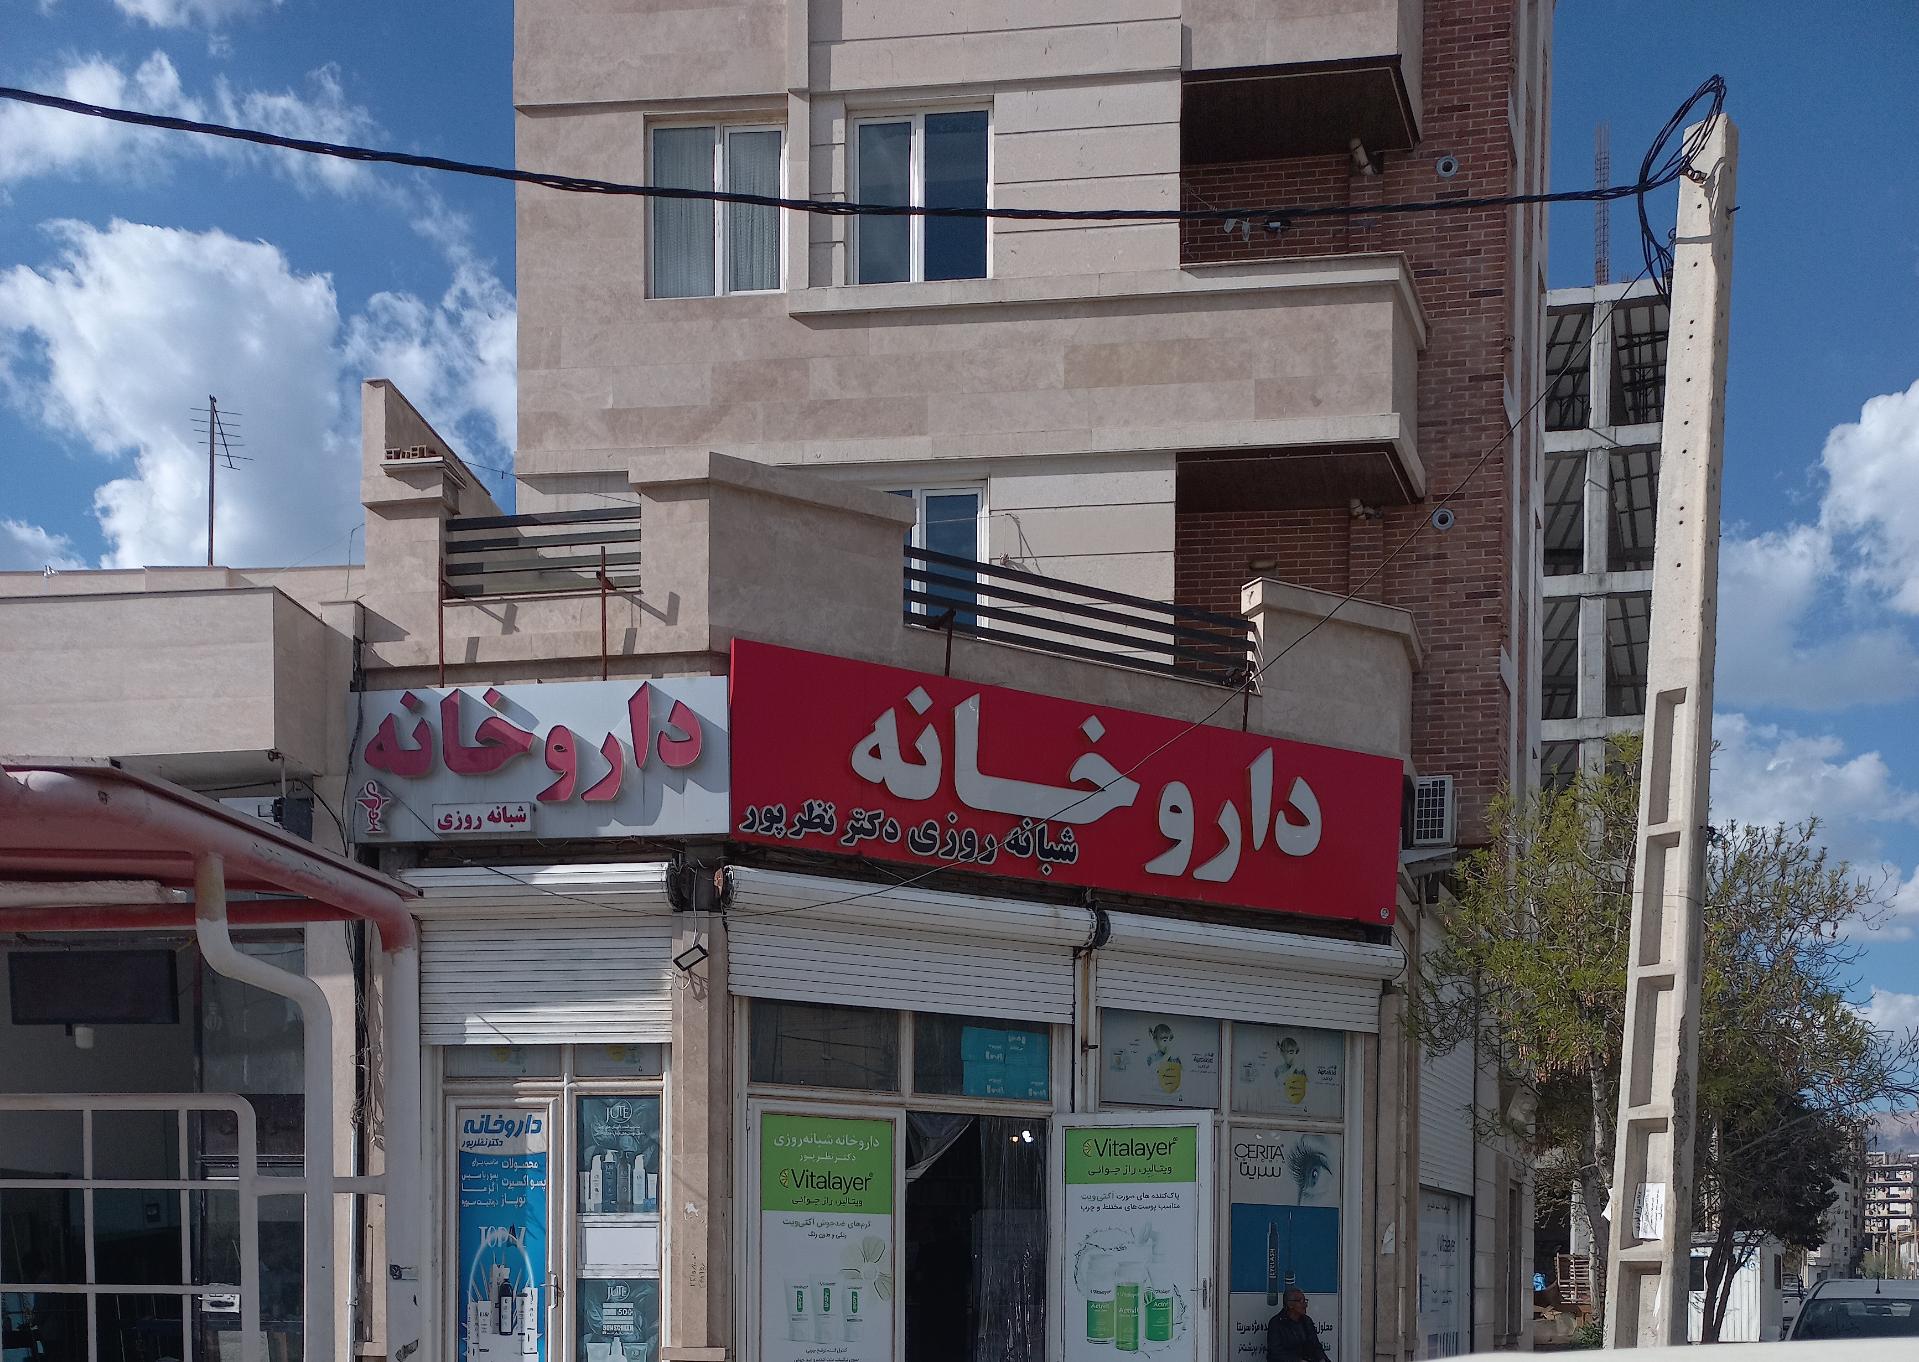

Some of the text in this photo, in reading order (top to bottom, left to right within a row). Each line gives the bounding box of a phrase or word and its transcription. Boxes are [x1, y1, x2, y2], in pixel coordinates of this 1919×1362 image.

[364, 679, 702, 802] داروخانه
[850, 685, 1323, 883] داروخانه
[437, 805, 527, 831] شبانه روزی
[738, 799, 1079, 876] شبانه روزی دکتر نظر پور
[605, 1105, 630, 1123] JUTE
[463, 1114, 542, 1138] داروخانه
[835, 1133, 880, 1151] داروخانه
[1234, 1143, 1285, 1161] CERITA
[501, 1157, 539, 1171] محصولات
[1088, 1163, 1121, 1176] جوانی
[1122, 1164, 1135, 1175] راز
[501, 1193, 526, 1208] توپاز
[478, 1223, 529, 1249] TOPAZ
[606, 1285, 627, 1301] JUTE
